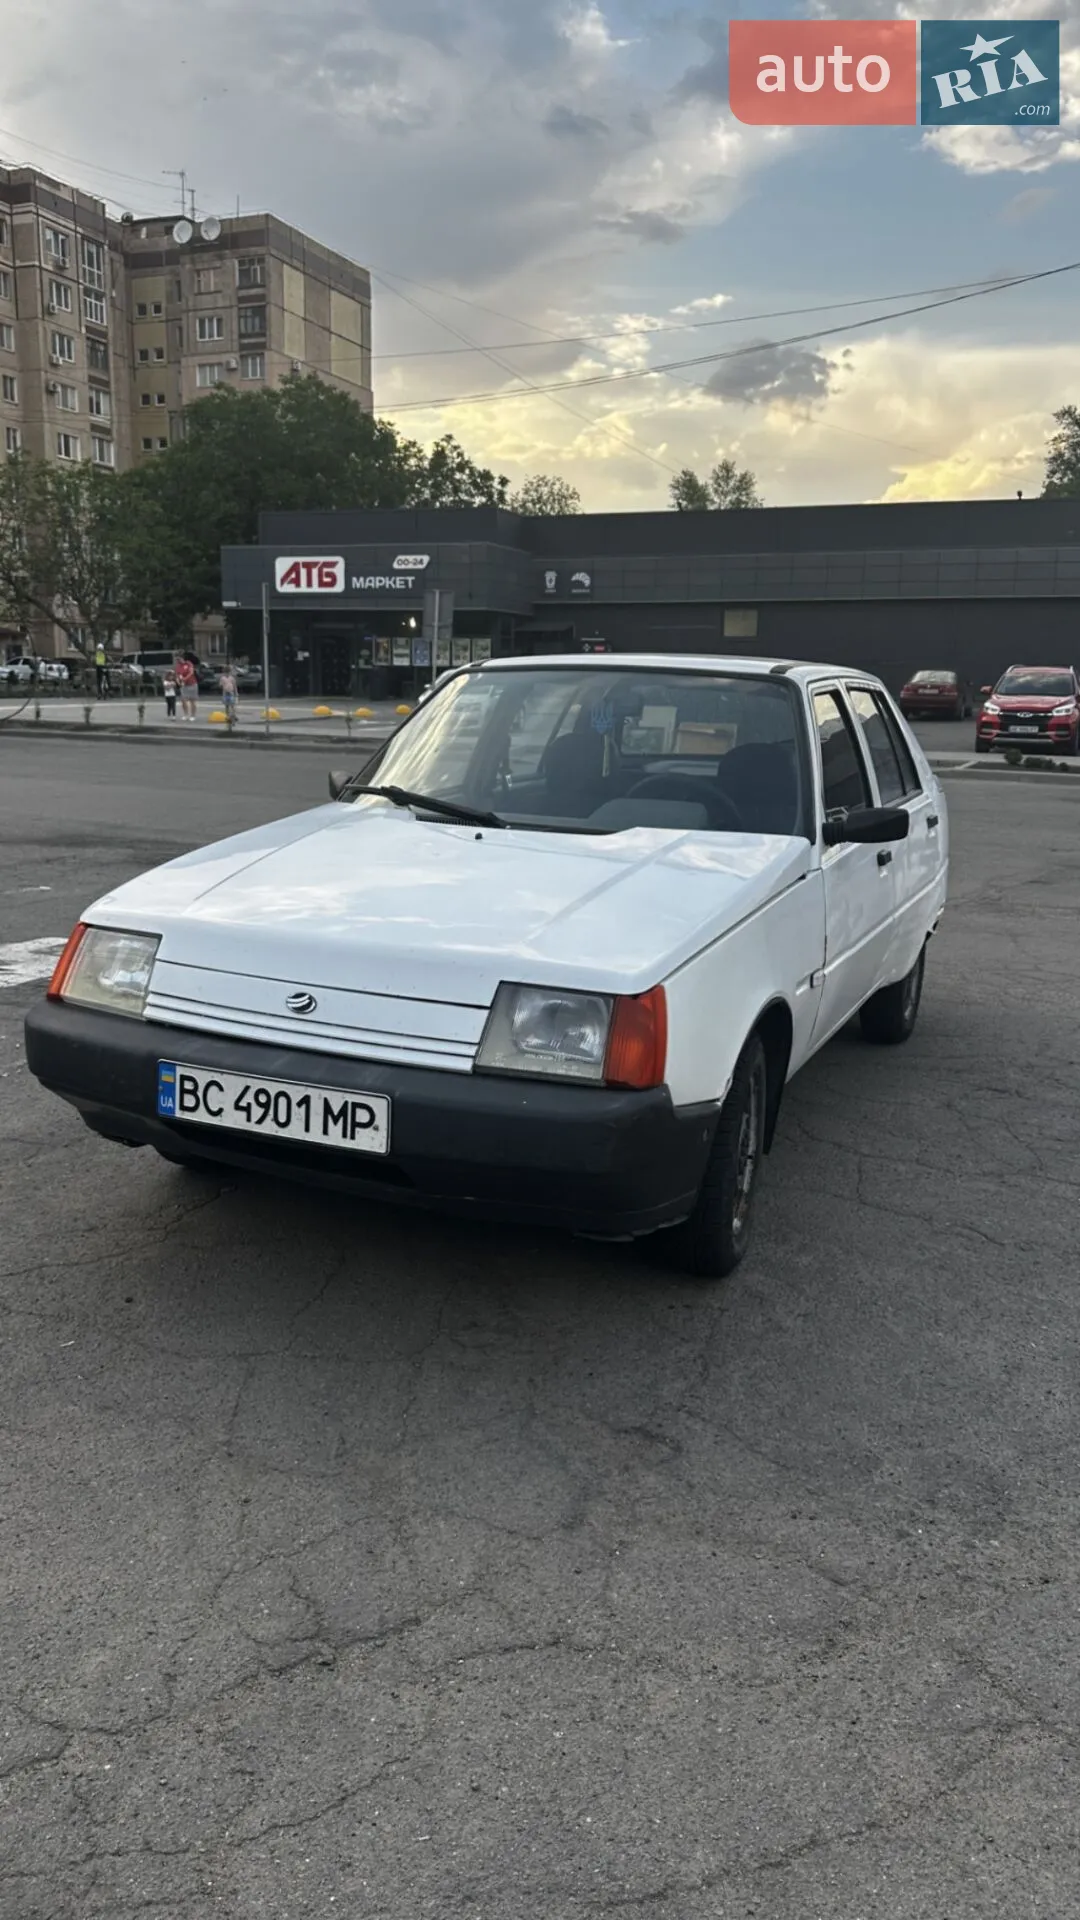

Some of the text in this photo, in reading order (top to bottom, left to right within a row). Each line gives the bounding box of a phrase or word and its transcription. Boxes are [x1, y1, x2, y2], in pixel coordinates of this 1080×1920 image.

[280, 561, 416, 589] АТБ МАРКЕТ
[160, 1094, 174, 1109] UA
[179, 1074, 376, 1140] BC 4901 MP
